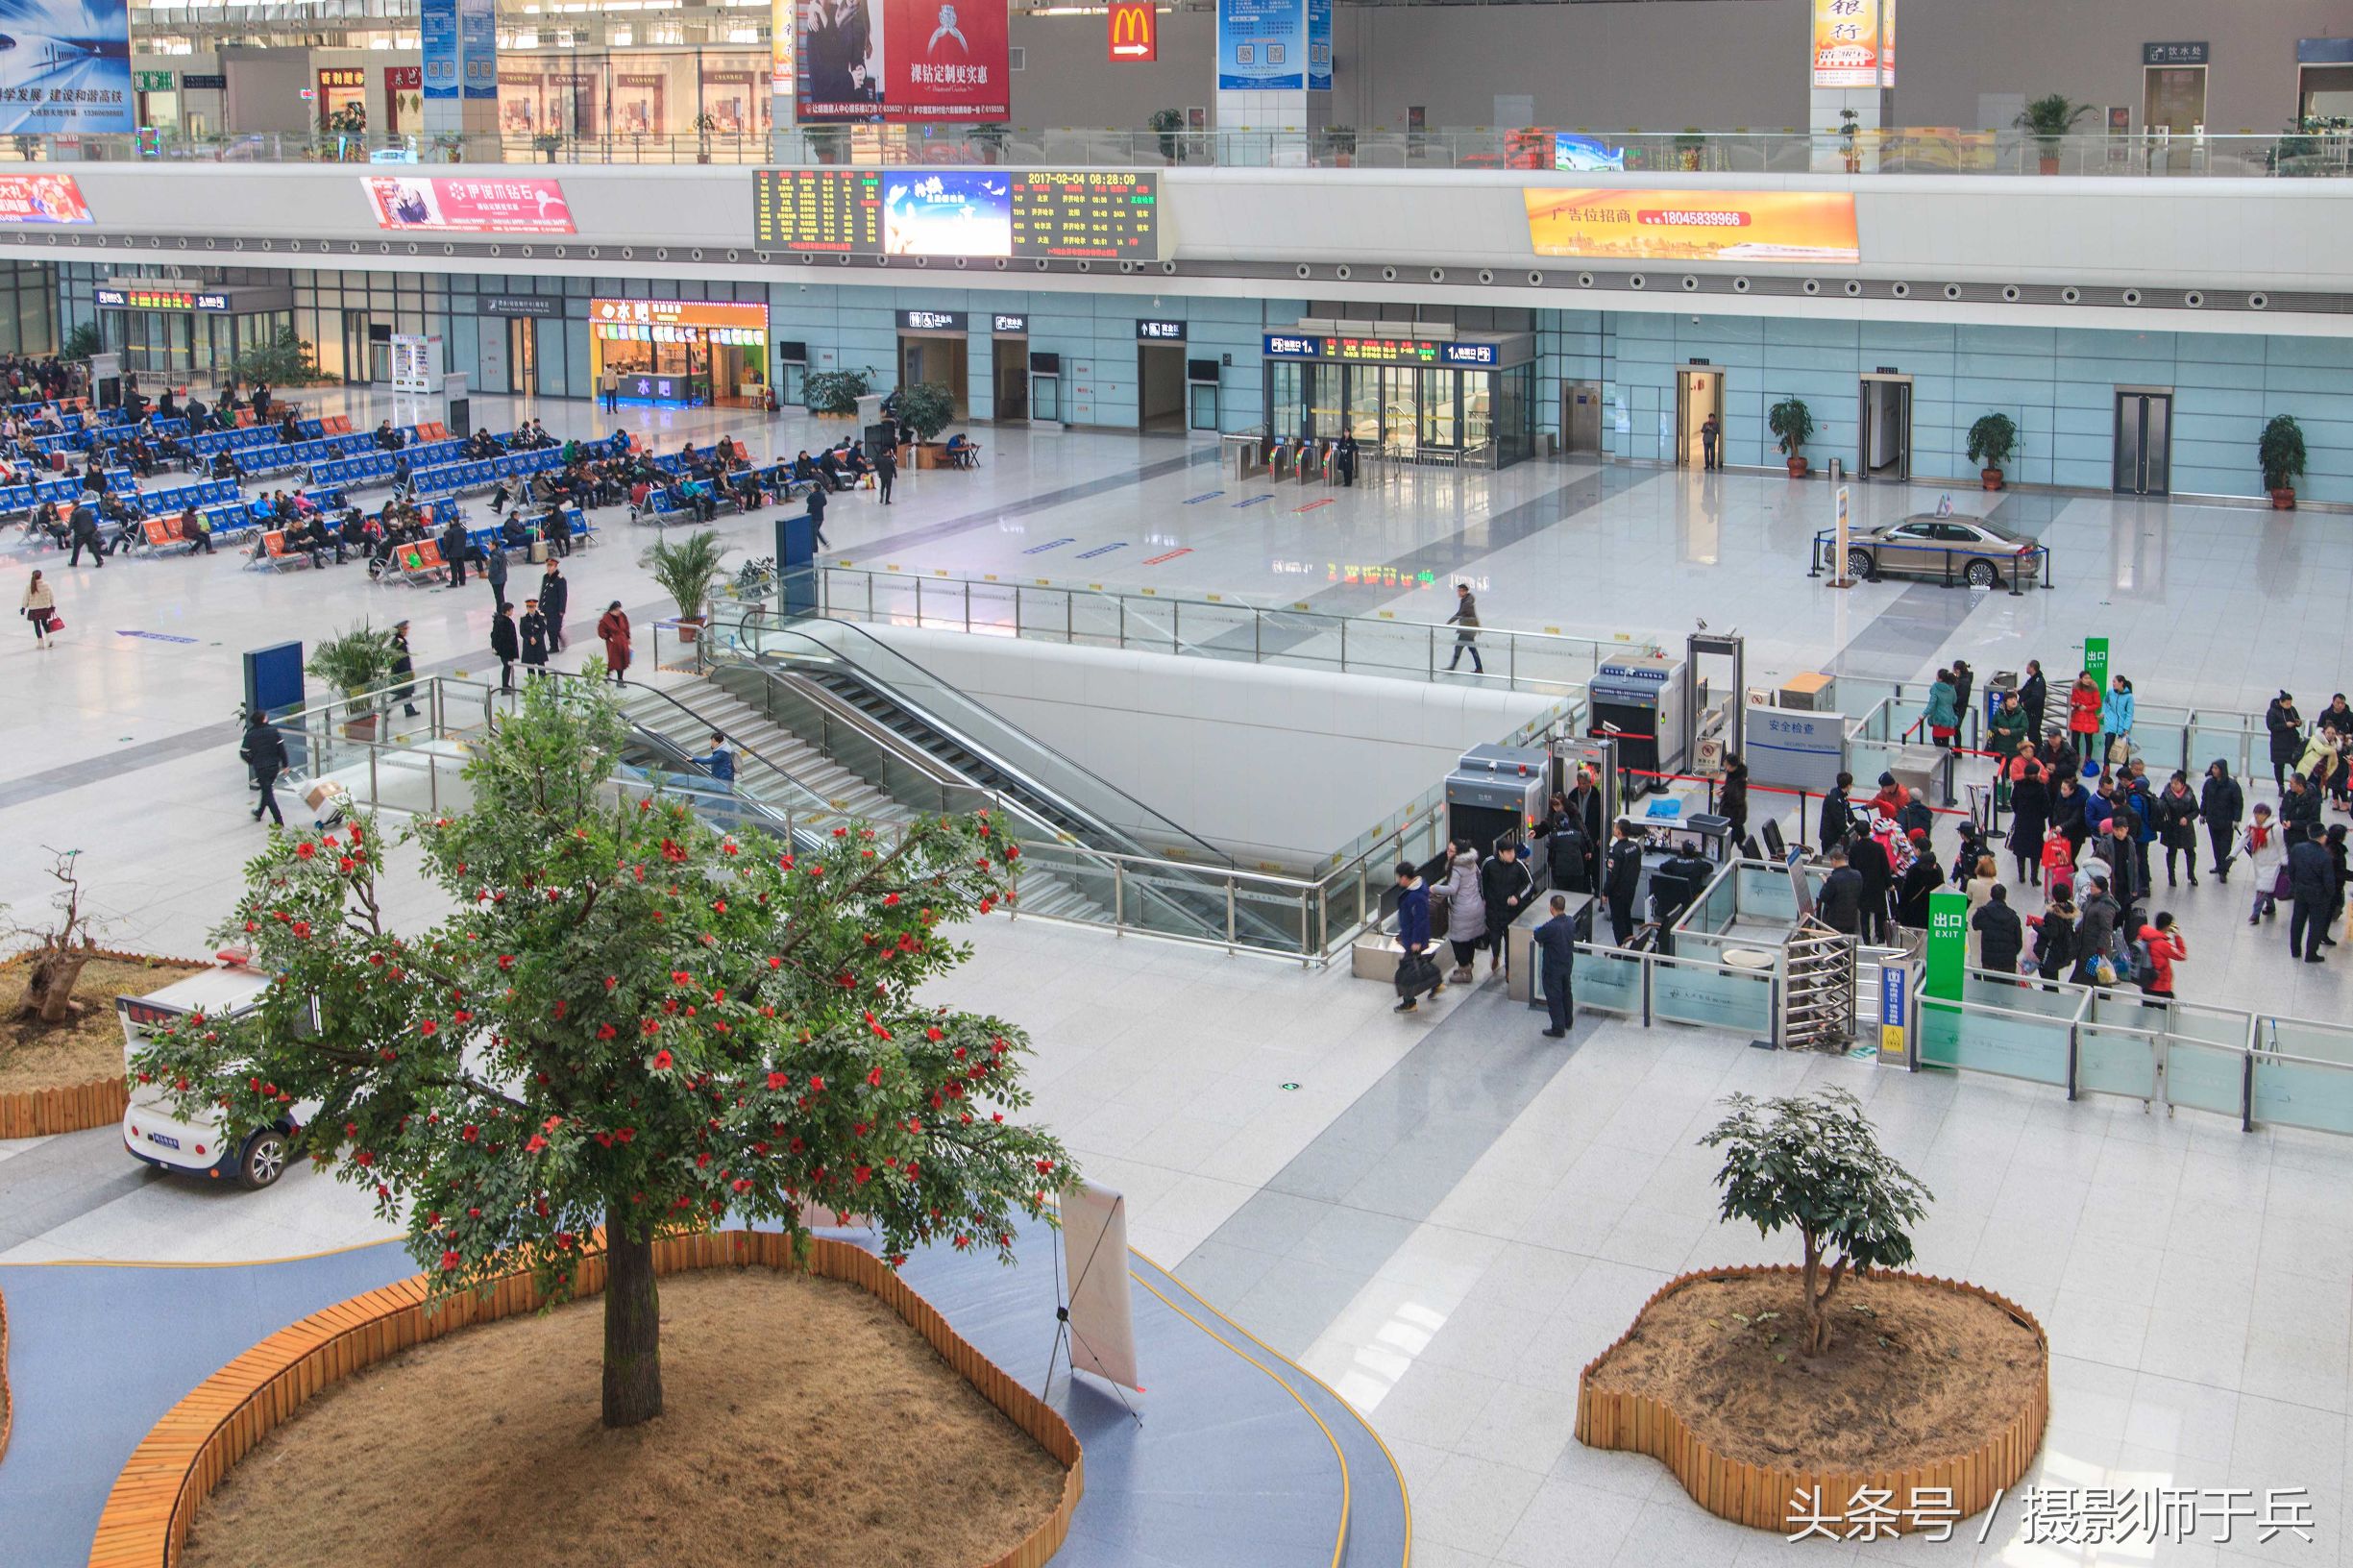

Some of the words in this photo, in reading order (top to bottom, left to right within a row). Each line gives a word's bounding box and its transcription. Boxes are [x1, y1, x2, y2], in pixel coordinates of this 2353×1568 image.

[2169, 46, 2201, 56] 饮水处
[911, 63, 988, 85] 裸钻定制更实惠
[50, 87, 122, 103] 建设和谐高铁
[1028, 173, 1085, 184] 2017-02-04
[1090, 174, 1137, 185] 08:28:09
[1552, 207, 1631, 224] 广告位招商
[1662, 211, 1741, 226] 18045839966
[617, 302, 650, 322] 水吧
[1161, 324, 1179, 332] 商业区
[1301, 339, 1313, 354] 1A
[1447, 346, 1459, 360] 1A
[637, 379, 671, 397] 水吧
[2087, 650, 2106, 661] 出口
[1769, 719, 1815, 735] 安全检查
[1933, 912, 1962, 928] 出口
[1935, 929, 1959, 939] EXIT
